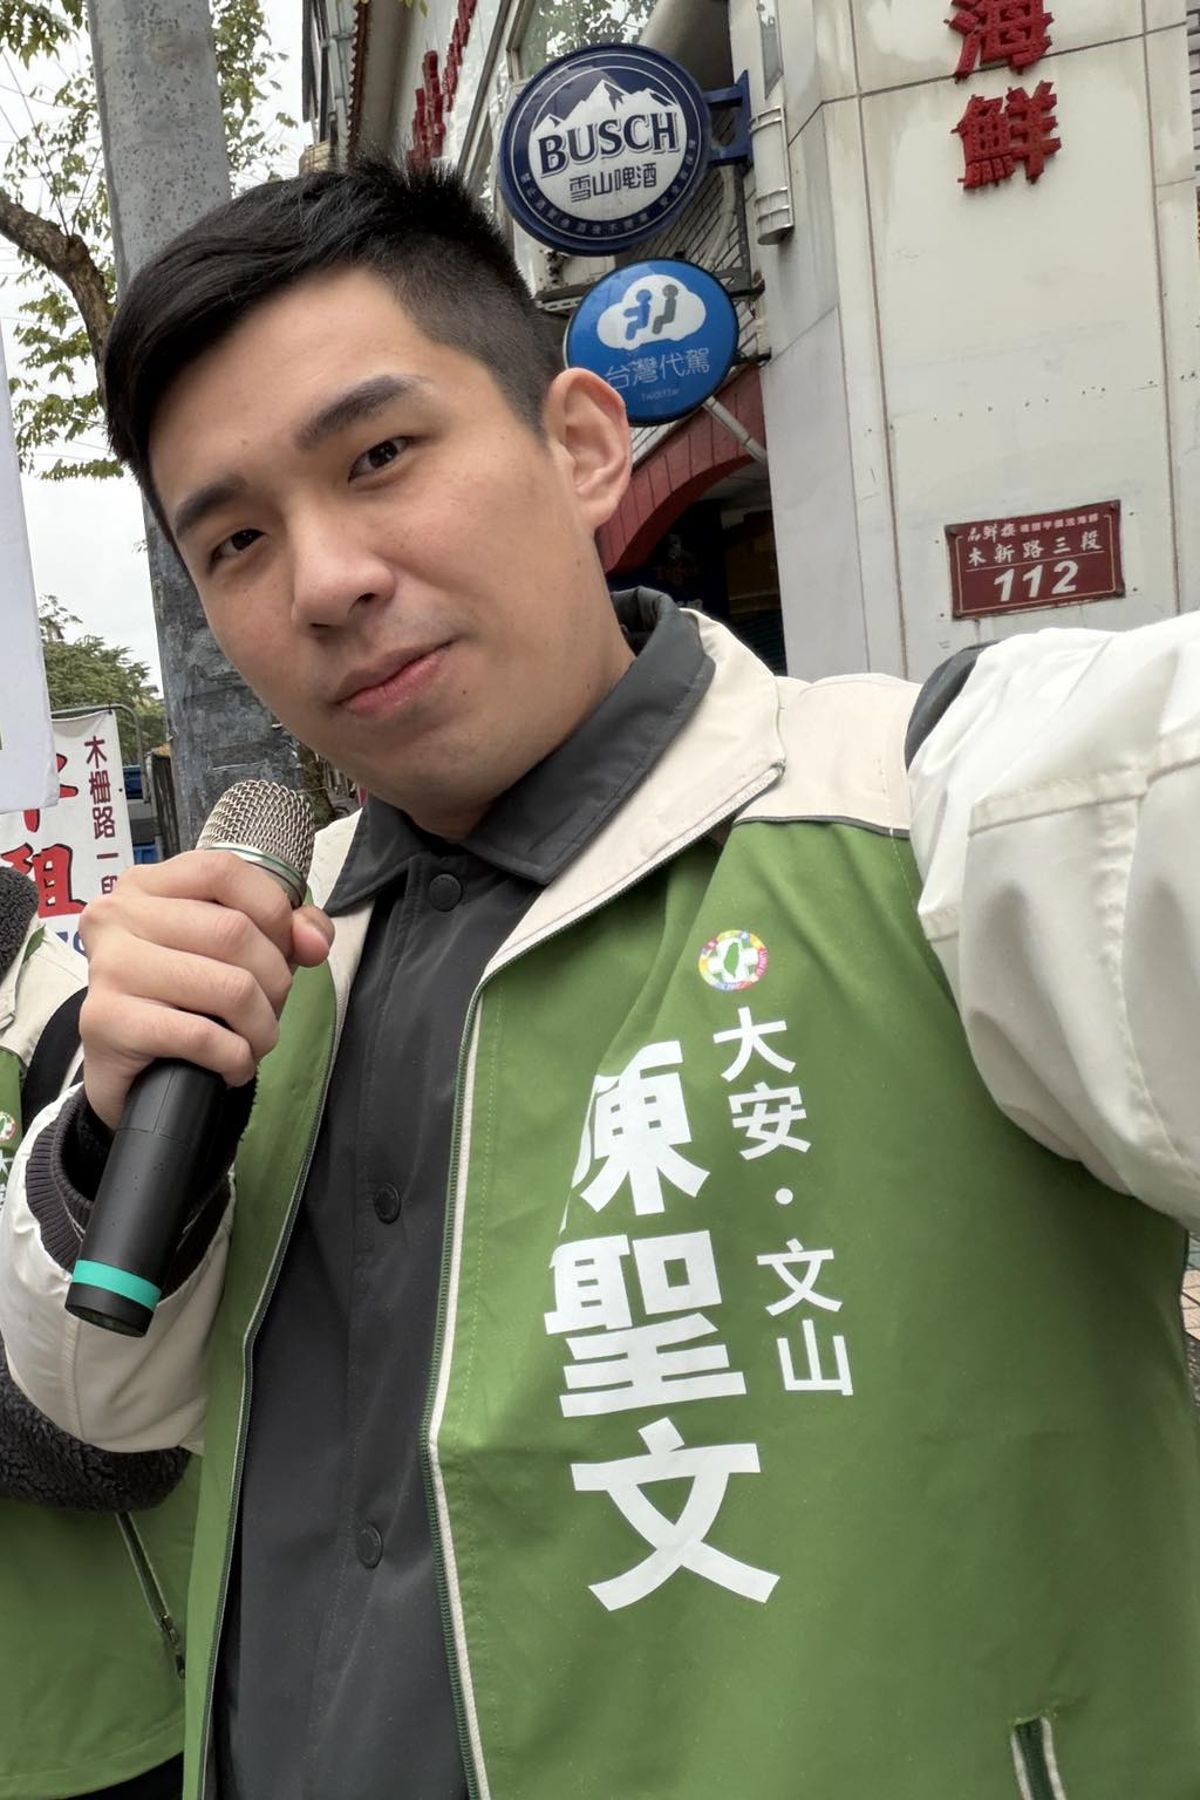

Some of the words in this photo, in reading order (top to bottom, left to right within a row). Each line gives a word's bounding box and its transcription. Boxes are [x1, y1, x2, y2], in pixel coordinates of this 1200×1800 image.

[948, 0, 1062, 189] 海鮮
[537, 111, 680, 179] BUSCH
[568, 162, 658, 203] 雪山啤酒
[603, 346, 711, 390] 台灣代駕
[967, 529, 1103, 567] 木新路三段
[993, 559, 1080, 603] 112
[544, 1040, 781, 1612] 陳聖文
